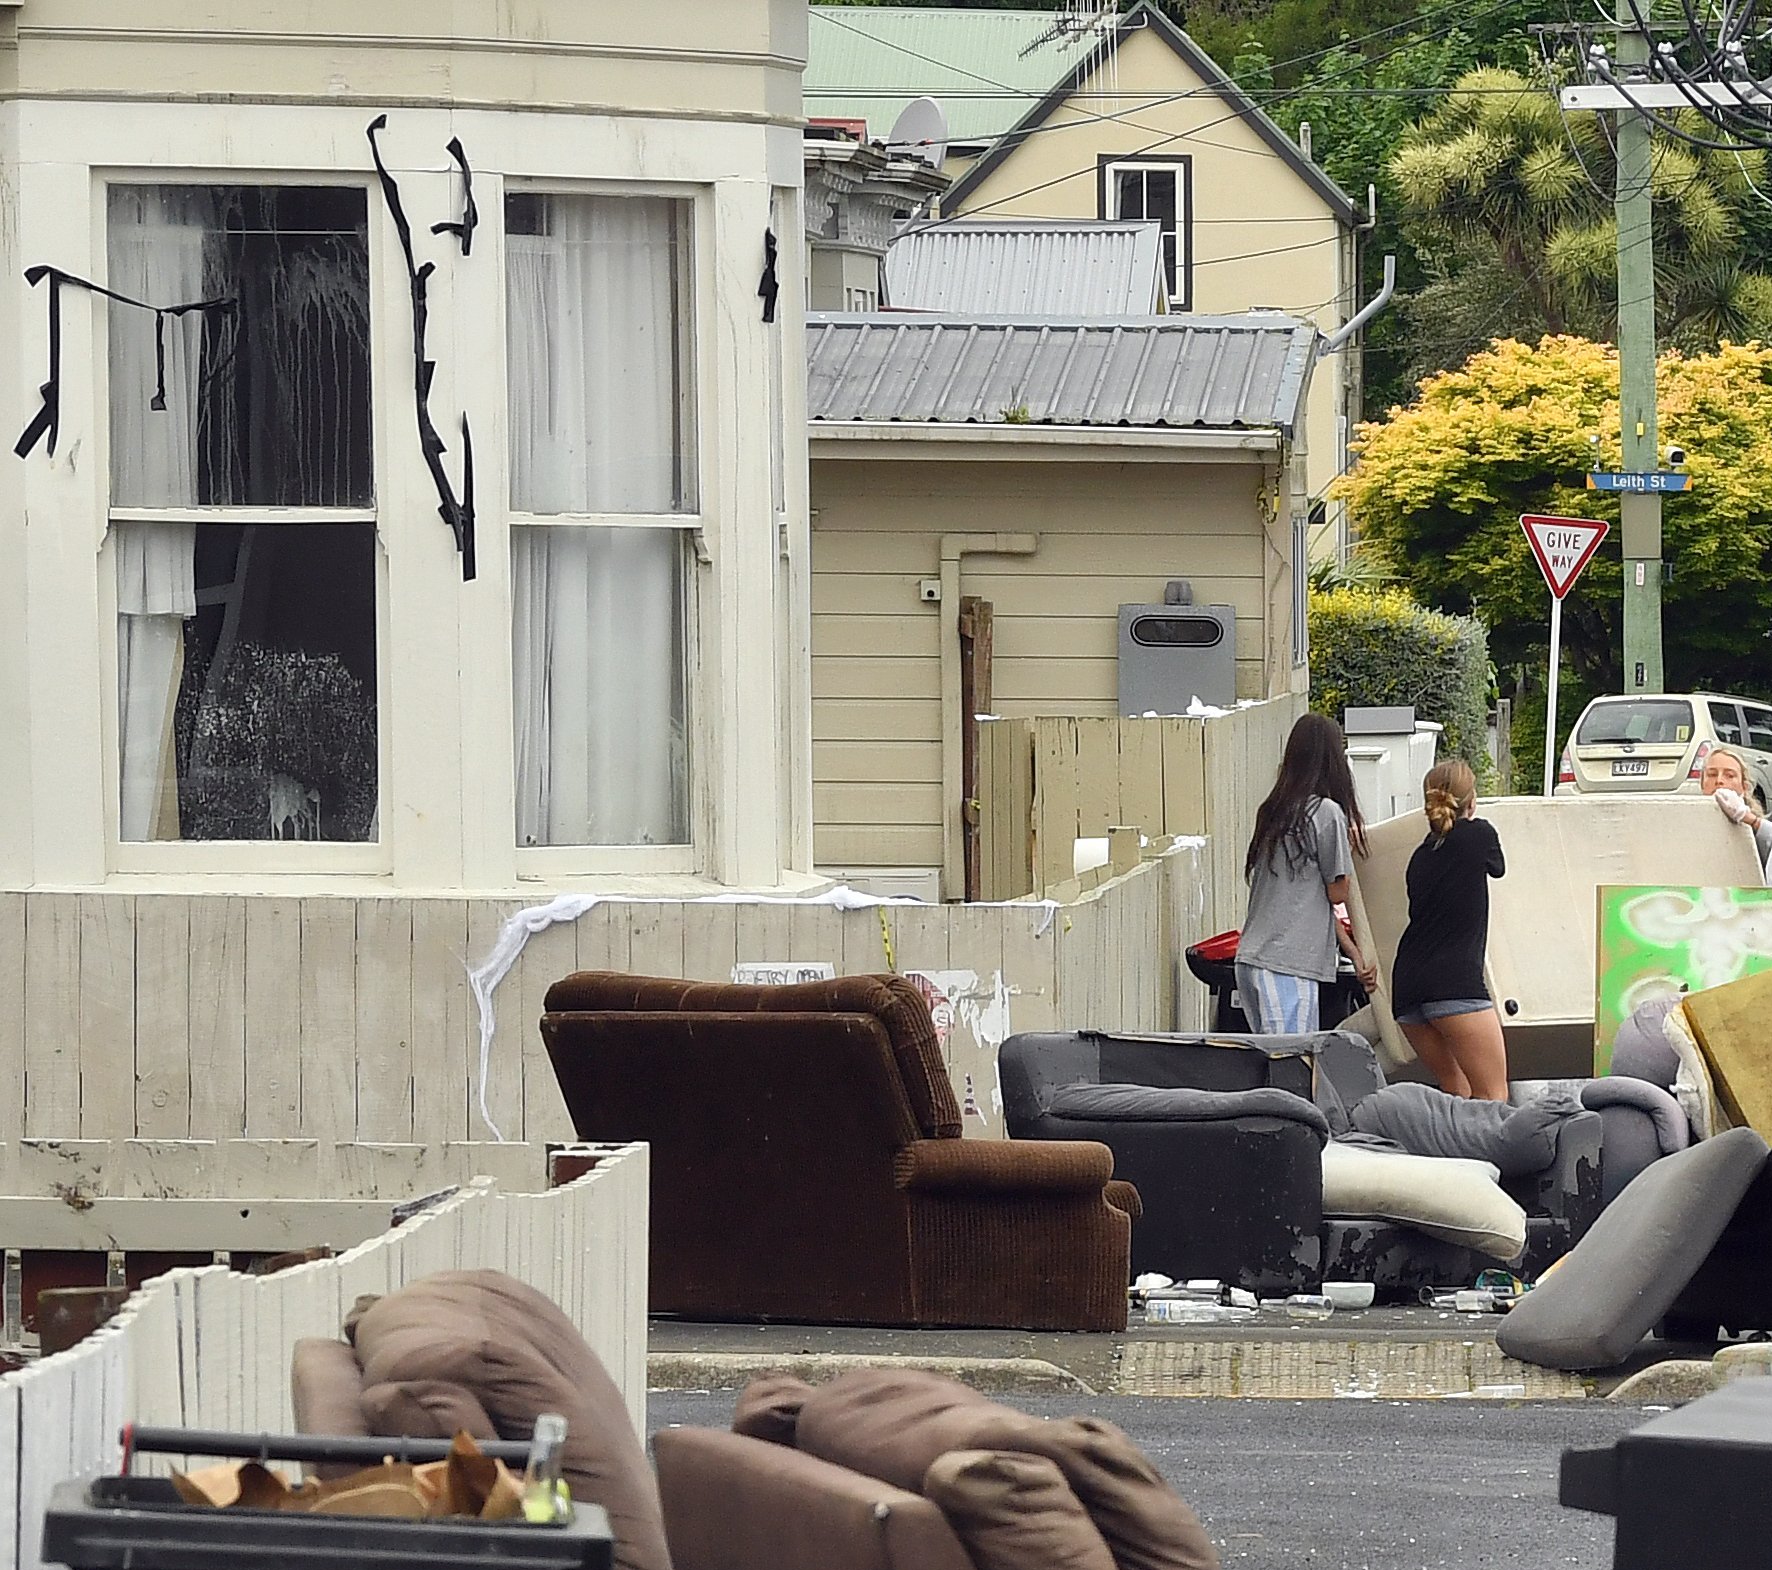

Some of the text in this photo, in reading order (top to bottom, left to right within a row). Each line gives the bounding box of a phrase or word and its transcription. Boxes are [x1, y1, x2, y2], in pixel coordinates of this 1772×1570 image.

[1612, 474, 1666, 488] Leith St
[1546, 531, 1581, 550] GIVE
[1552, 555, 1574, 569] WAY
